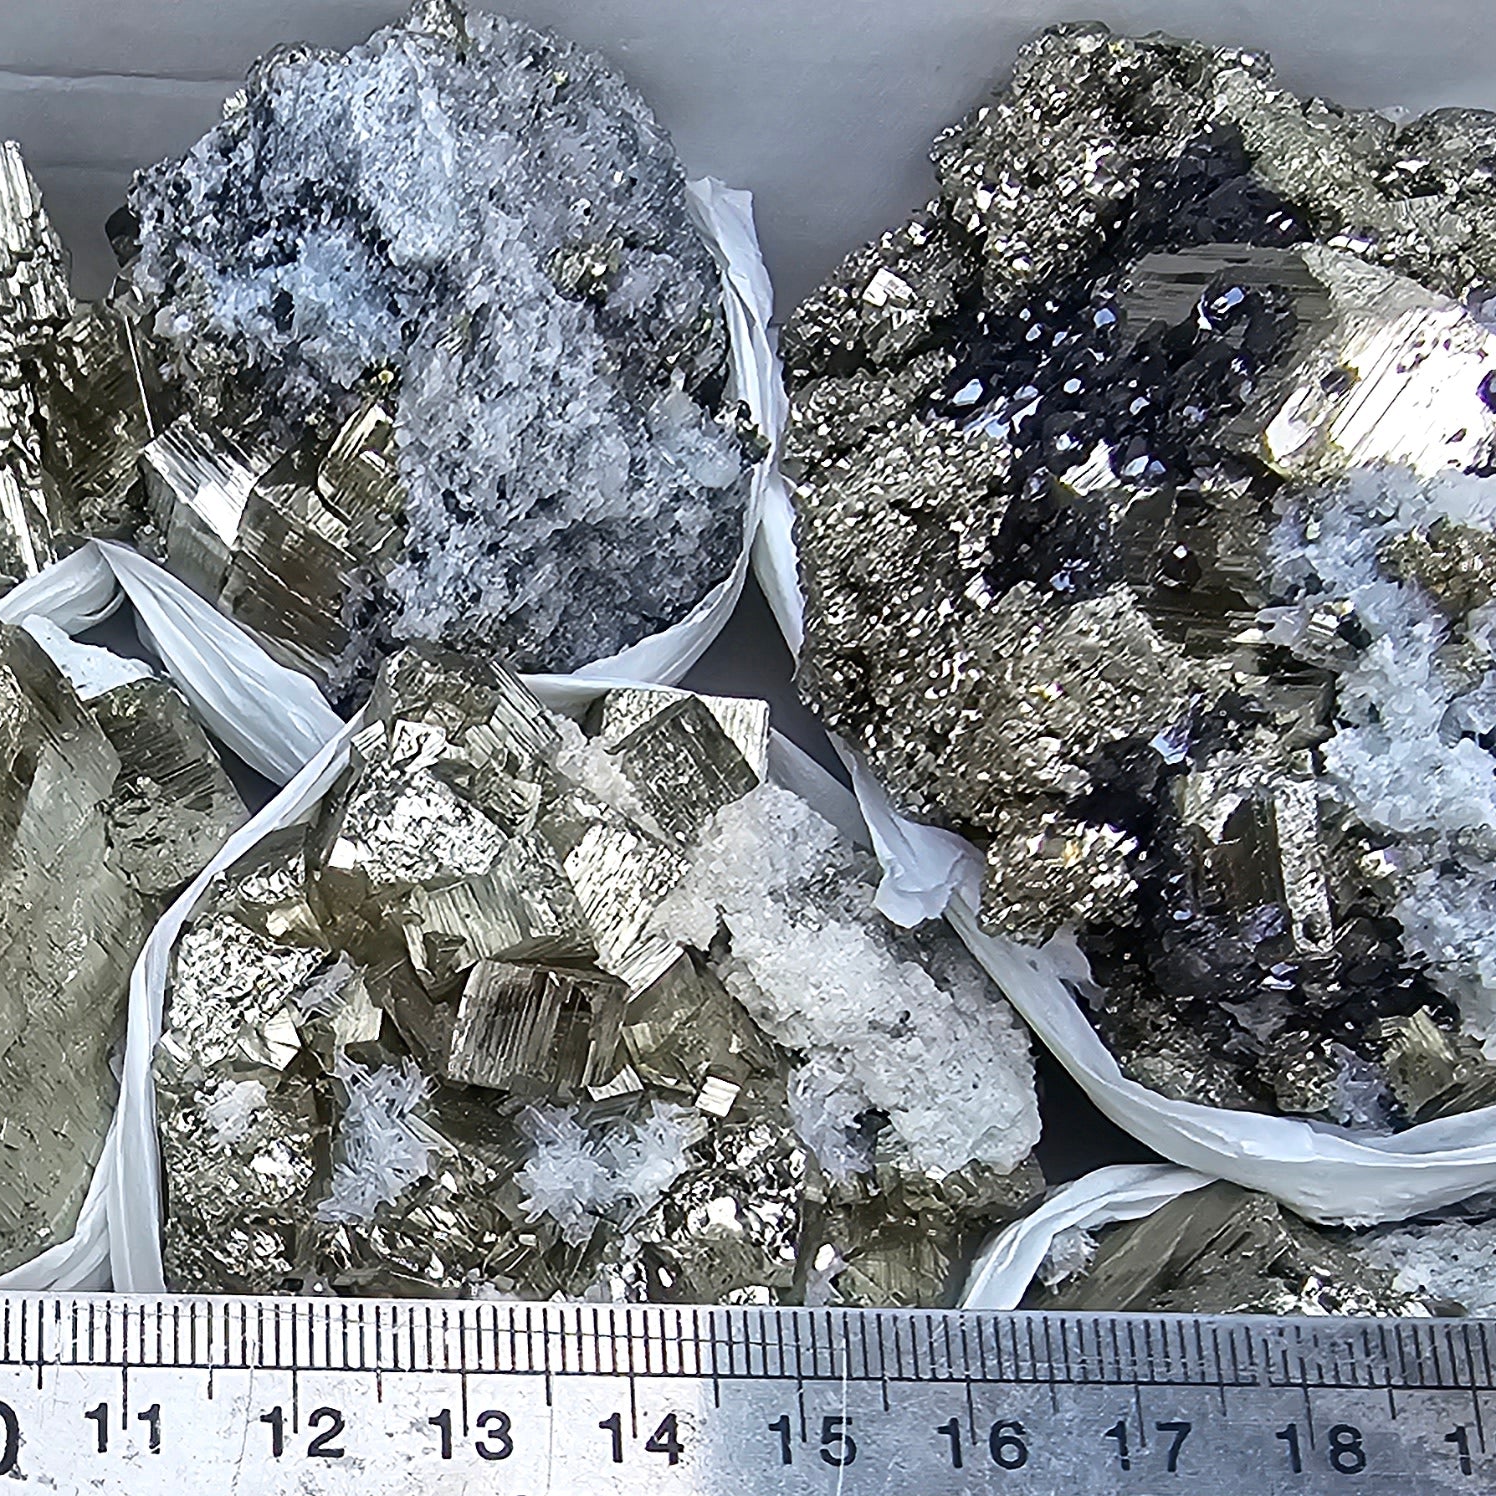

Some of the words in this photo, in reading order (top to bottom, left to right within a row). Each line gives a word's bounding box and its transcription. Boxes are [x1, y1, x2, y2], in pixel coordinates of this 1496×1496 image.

[84, 1402, 161, 1454] 11
[259, 1406, 345, 1458] 12
[428, 1408, 513, 1461] 13
[599, 1412, 684, 1465] 14
[768, 1414, 857, 1467] 15
[936, 1417, 1030, 1470] 16
[1105, 1420, 1192, 1472] 17
[1276, 1423, 1366, 1475] 18
